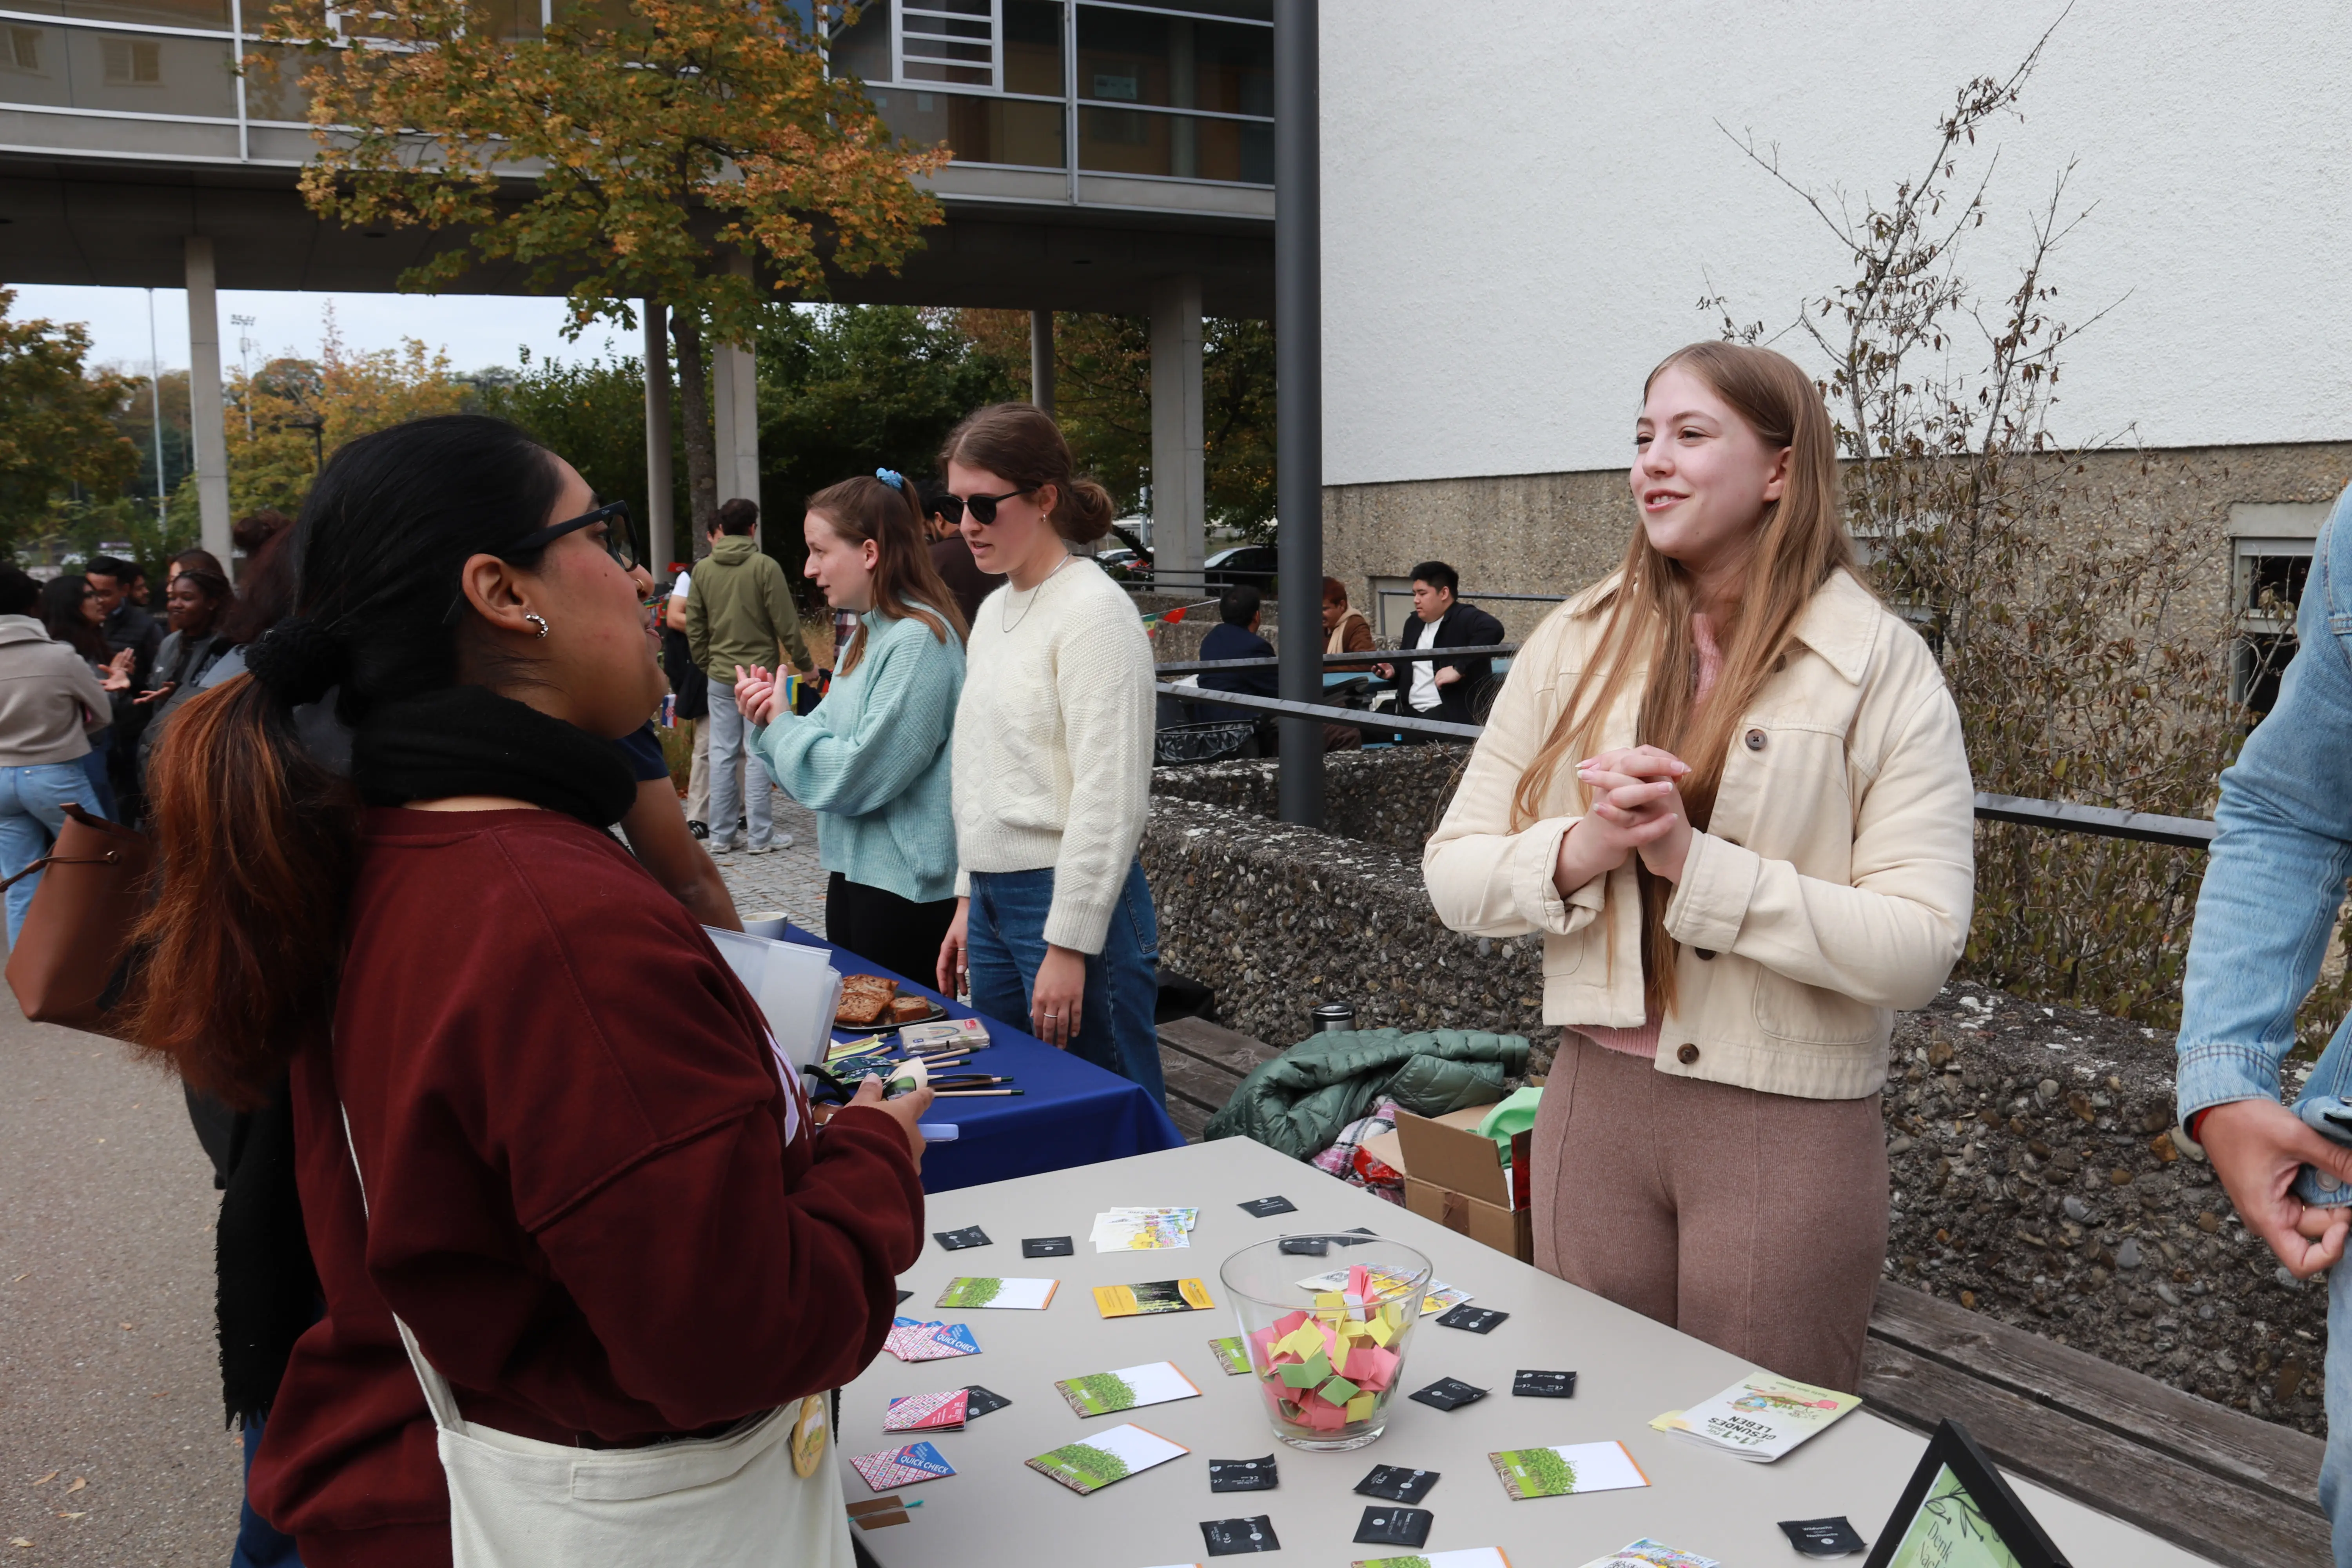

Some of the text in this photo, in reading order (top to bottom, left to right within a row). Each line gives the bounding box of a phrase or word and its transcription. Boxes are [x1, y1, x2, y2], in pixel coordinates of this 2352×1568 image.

[937, 1334, 977, 1353] QUICK CHECK
[1708, 1417, 1777, 1440] GESUNDES
[1728, 1416, 1773, 1433] LEBEN
[900, 1455, 949, 1474] QUICK CHECK
[1927, 1521, 1953, 1564] Denk
